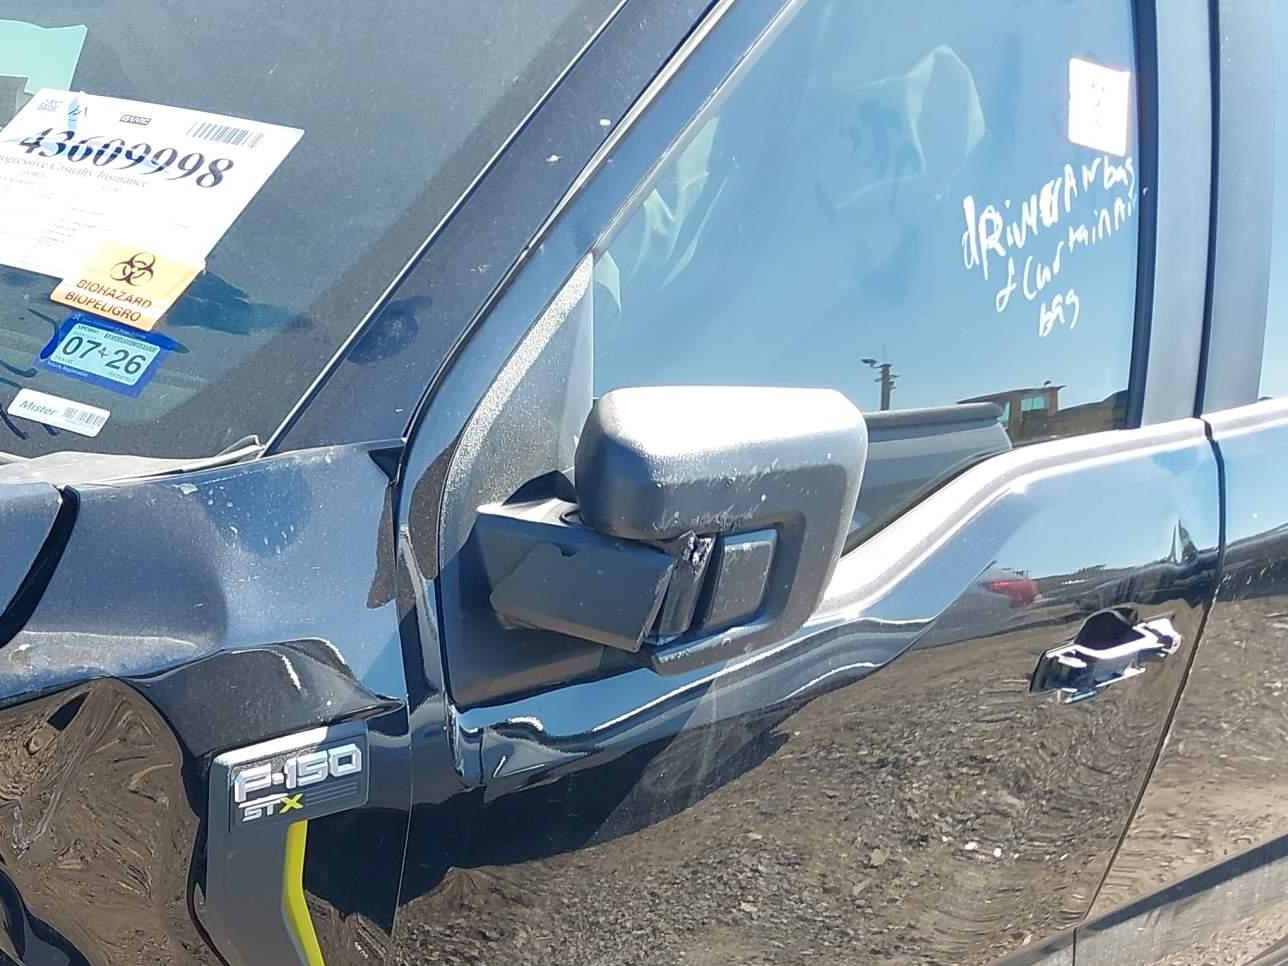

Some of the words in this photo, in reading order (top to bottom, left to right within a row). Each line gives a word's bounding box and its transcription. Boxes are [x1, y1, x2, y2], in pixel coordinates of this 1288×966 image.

[18, 128, 234, 188] 43609998
[65, 291, 142, 322] BIOPELIGRO
[76, 279, 152, 310] BIOHAZARD
[62, 336, 102, 360] 07
[105, 349, 146, 375] 26
[234, 743, 362, 803] F-150
[239, 792, 305, 823] STX
